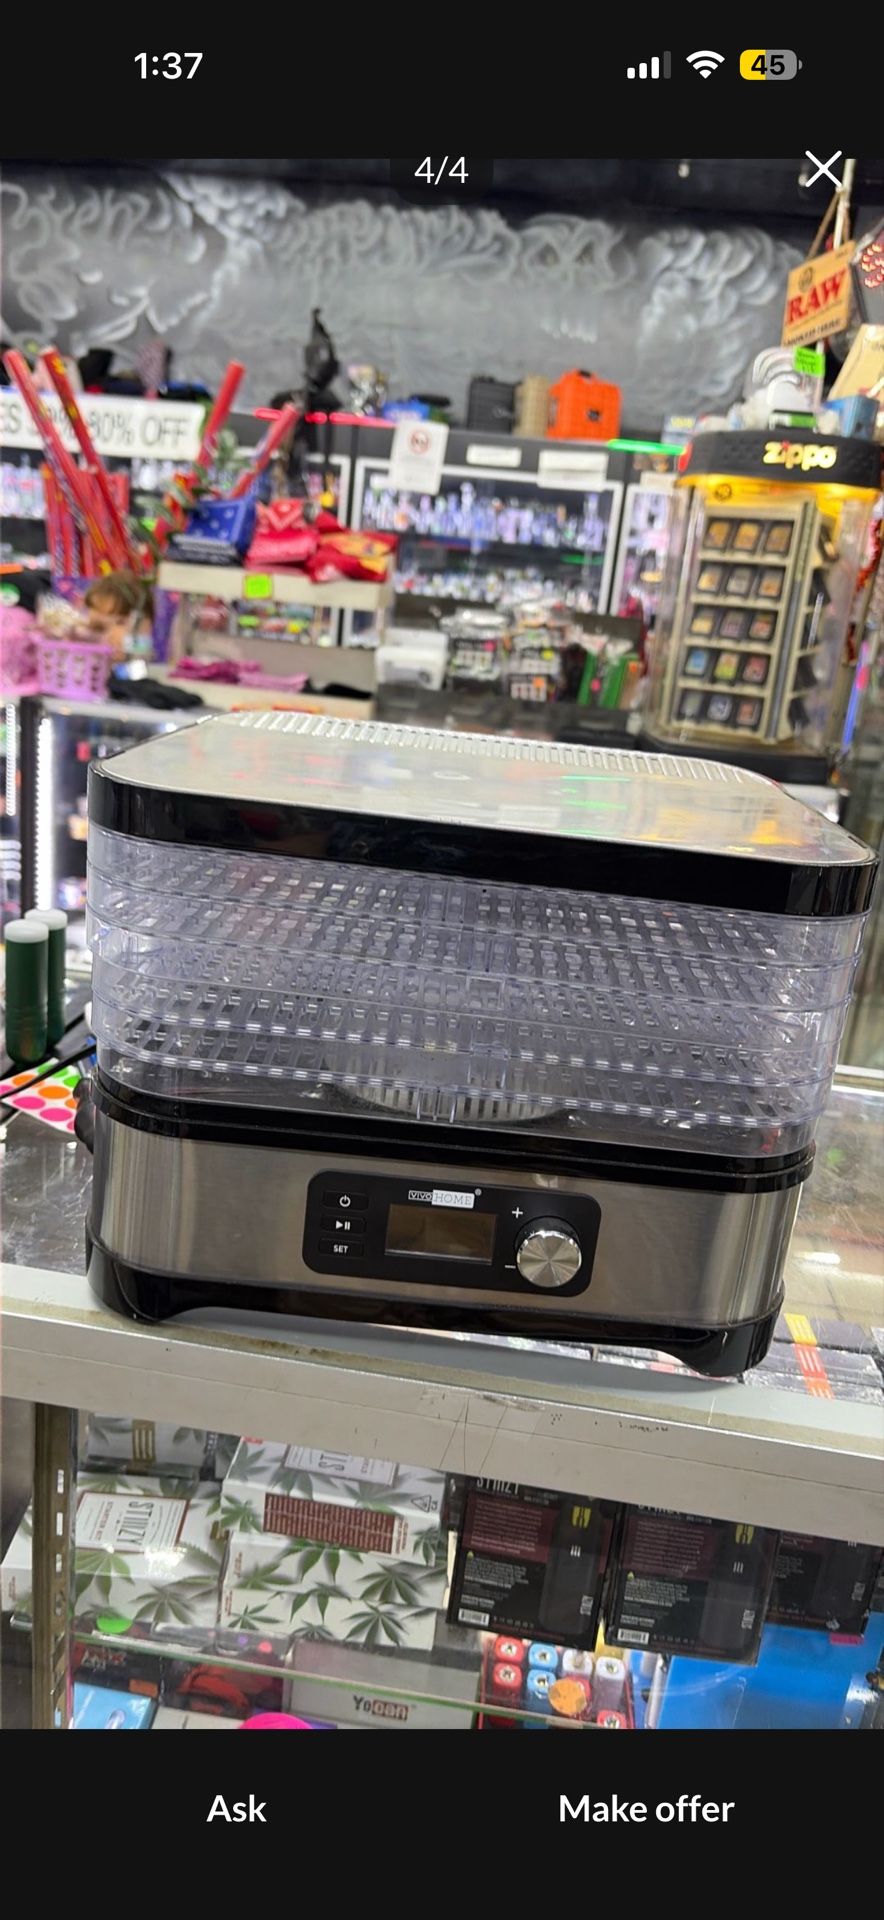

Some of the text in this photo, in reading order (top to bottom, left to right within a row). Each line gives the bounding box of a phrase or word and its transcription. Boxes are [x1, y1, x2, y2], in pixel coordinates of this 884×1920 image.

[788, 268, 848, 324] RAW
[139, 414, 190, 447] OFF
[333, 1244, 349, 1254] SET
